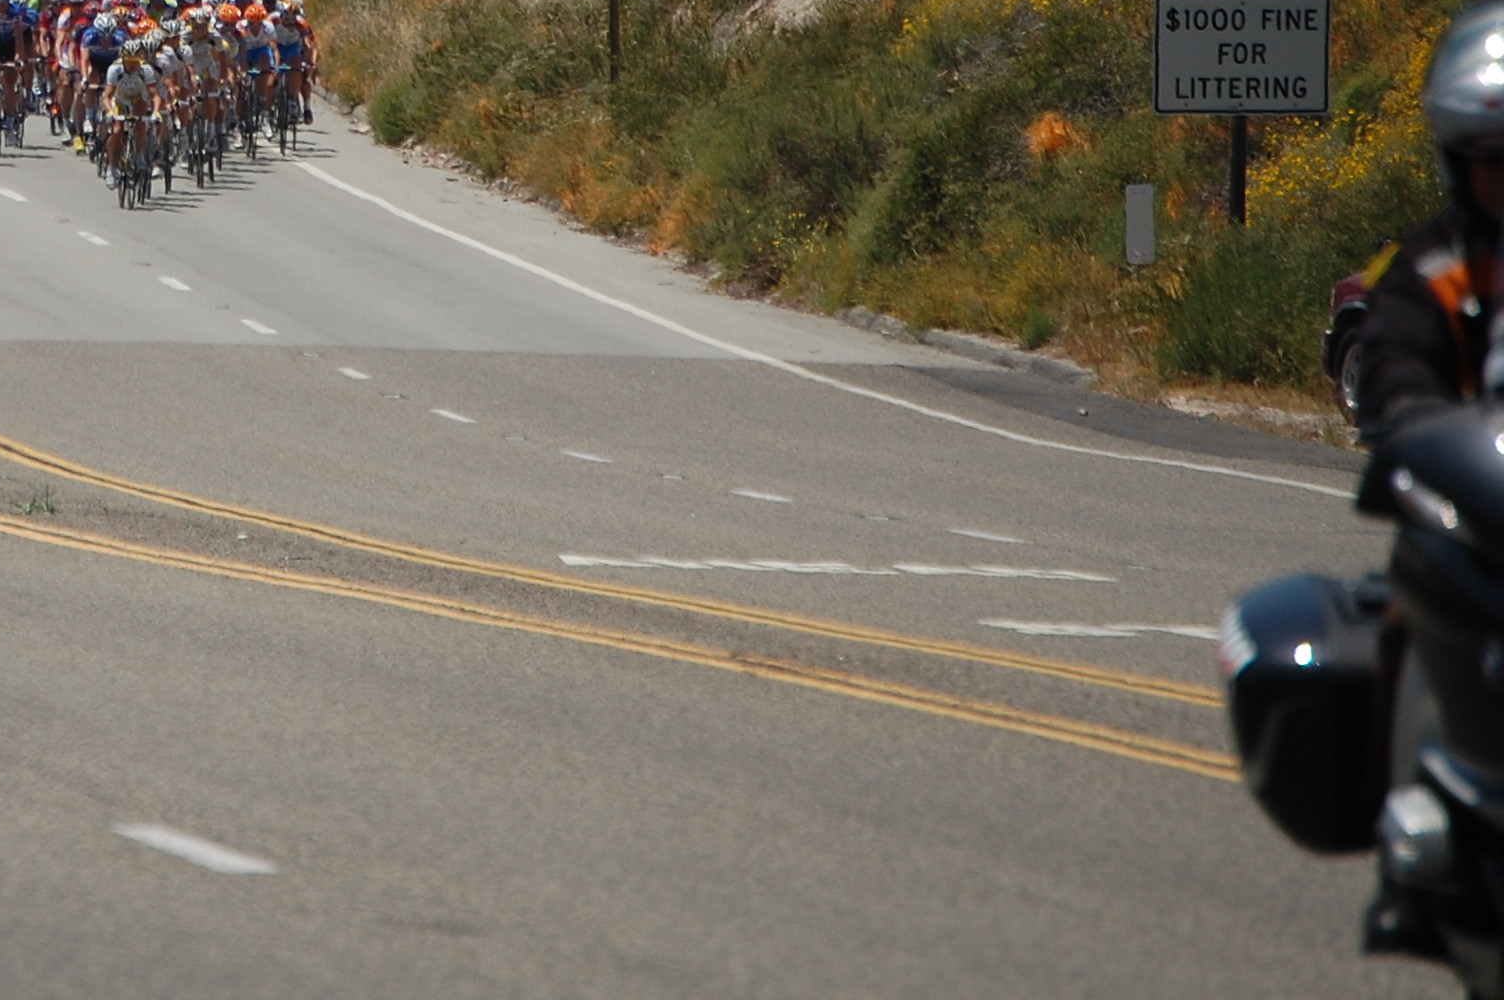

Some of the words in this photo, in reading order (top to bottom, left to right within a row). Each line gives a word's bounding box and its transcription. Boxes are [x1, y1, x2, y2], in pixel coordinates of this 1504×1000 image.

[1165, 7, 1246, 32] $1000
[1262, 9, 1318, 31] FINE
[1217, 42, 1267, 65] FOR
[1175, 76, 1308, 100] LITTERING
